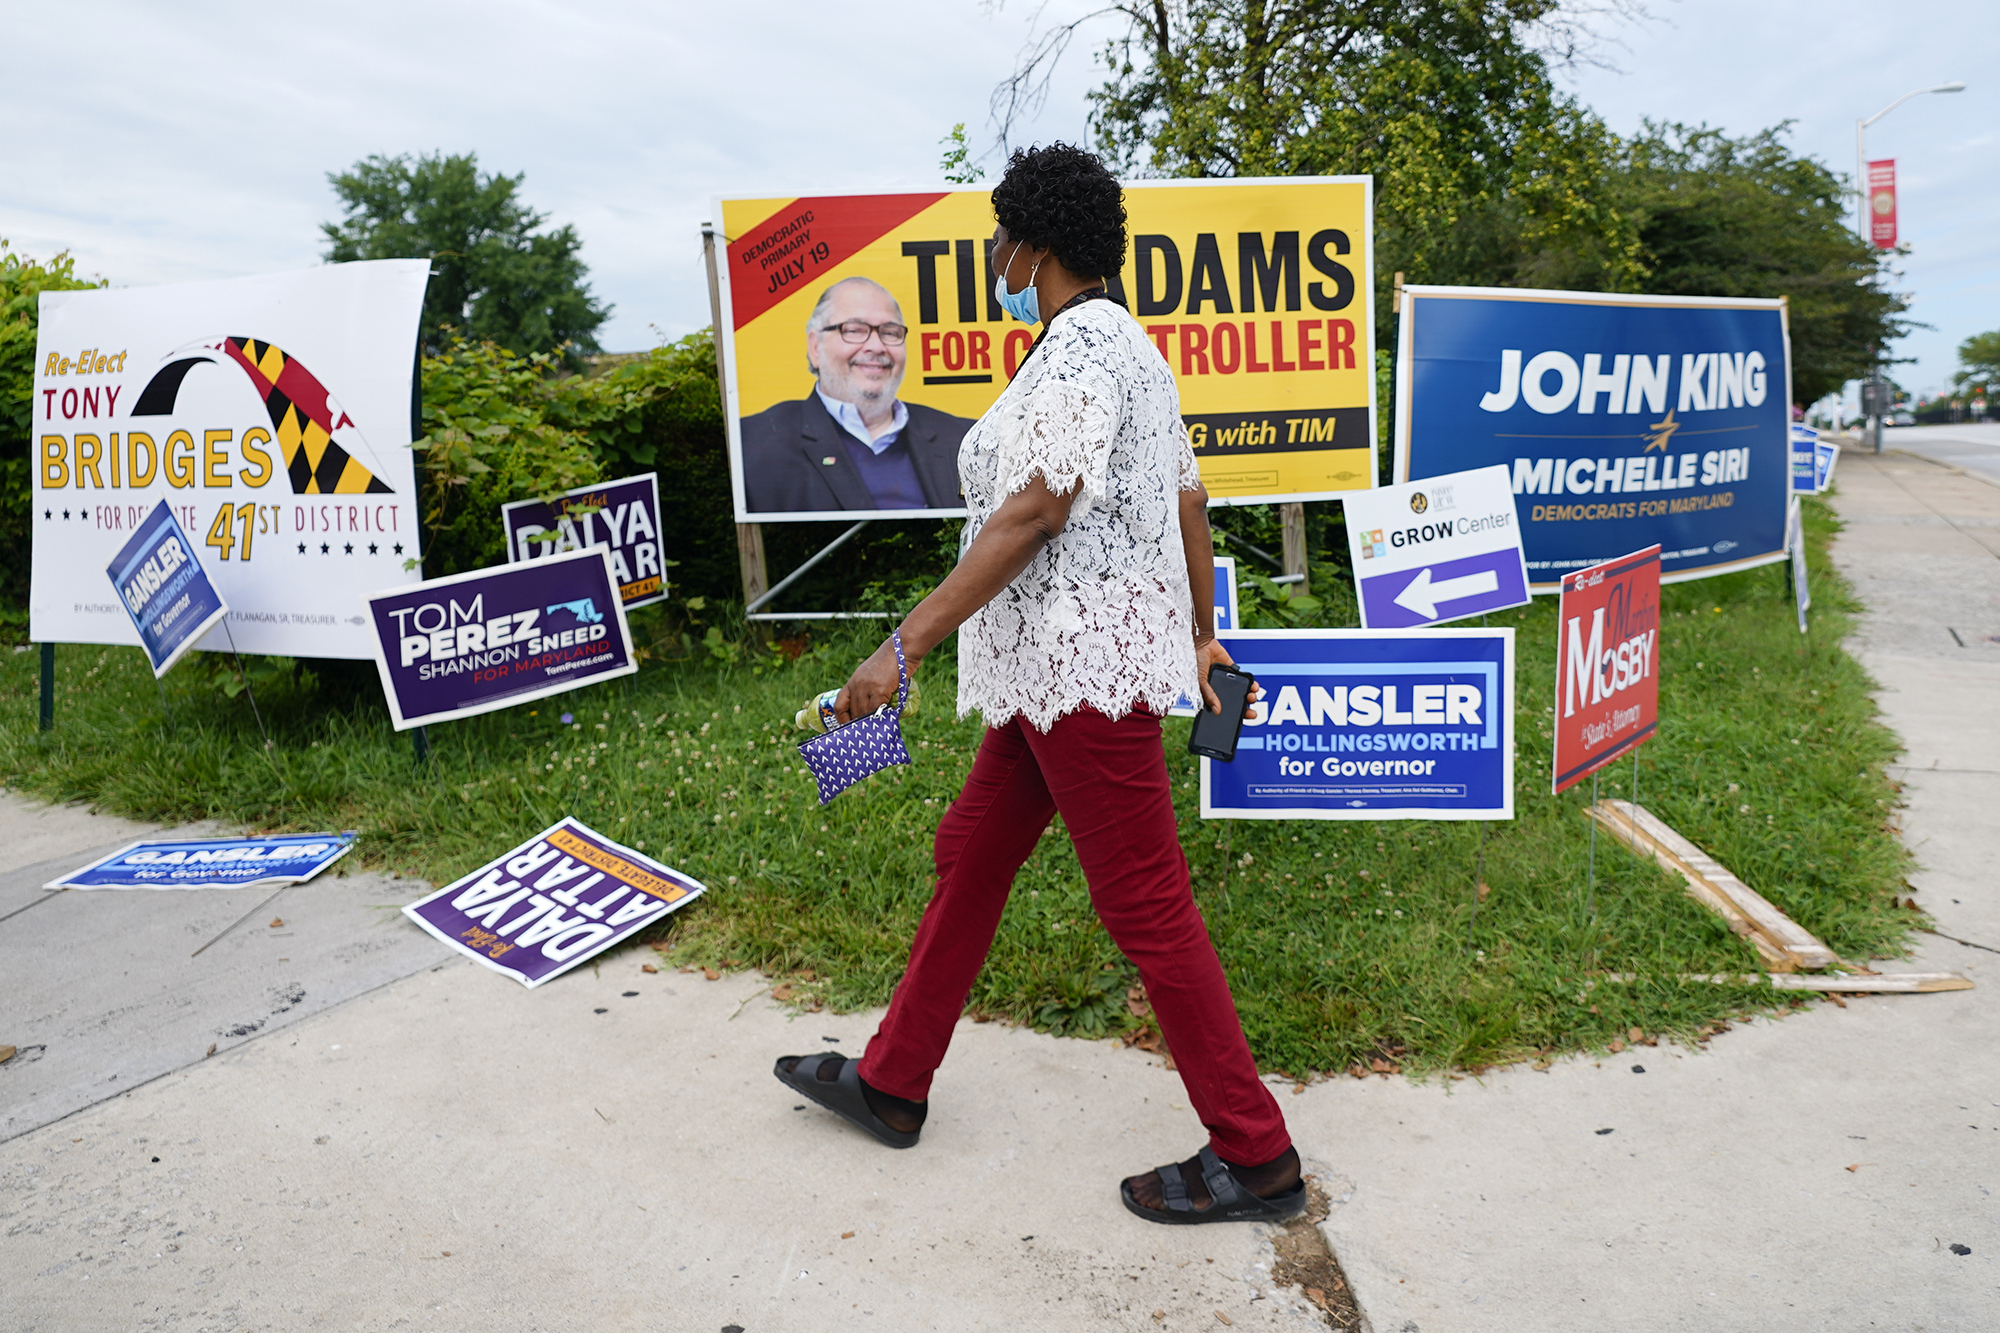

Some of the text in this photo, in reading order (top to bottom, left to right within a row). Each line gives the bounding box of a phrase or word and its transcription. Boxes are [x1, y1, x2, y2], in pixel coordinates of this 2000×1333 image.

[741, 210, 815, 265] DEMOCRATIC
[760, 229, 811, 271] PRIMARY
[767, 241, 830, 293] JULY 19
[1104, 229, 1355, 317] DAMS
[44, 348, 127, 377] Re-Elect
[921, 330, 991, 372] FOR
[43, 385, 121, 420] TONY
[1478, 349, 1767, 415] JOHN KING
[1215, 419, 1278, 447] with
[1285, 416, 1336, 444] TIM
[40, 427, 273, 490] BRIDGES
[1513, 447, 1750, 496] MICHELLE SIRI
[96, 506, 123, 531] FOR
[294, 505, 399, 533] DISTRICT
[1531, 491, 1735, 523] DEMOCRATS FOR MARYLAND
[516, 500, 656, 562] DALYA
[1391, 511, 1510, 548] GROW Center
[124, 535, 188, 616] GANSLER
[141, 564, 196, 628] HOLLINGSWORTH
[642, 581, 655, 593] 41
[1573, 570, 1605, 592] Re-elect
[153, 621, 163, 638] for
[161, 592, 192, 629] Governor
[388, 593, 485, 639] TOM
[401, 608, 541, 668] PEREZ
[419, 624, 607, 681] SHANNON SNEED
[474, 640, 611, 684] FOR MARYLAND
[544, 651, 615, 677] TomPerez.com
[1266, 732, 1479, 751] HOLLINGSWORTH
[1279, 756, 1436, 777] for Governor
[123, 843, 330, 865] GANSLER
[556, 834, 571, 846] 41
[570, 841, 620, 874] DISTRICT
[134, 867, 267, 879] for Governor
[505, 841, 666, 927] ATTAR
[451, 868, 614, 963] DALYA
[460, 925, 515, 959] Re-Elect
